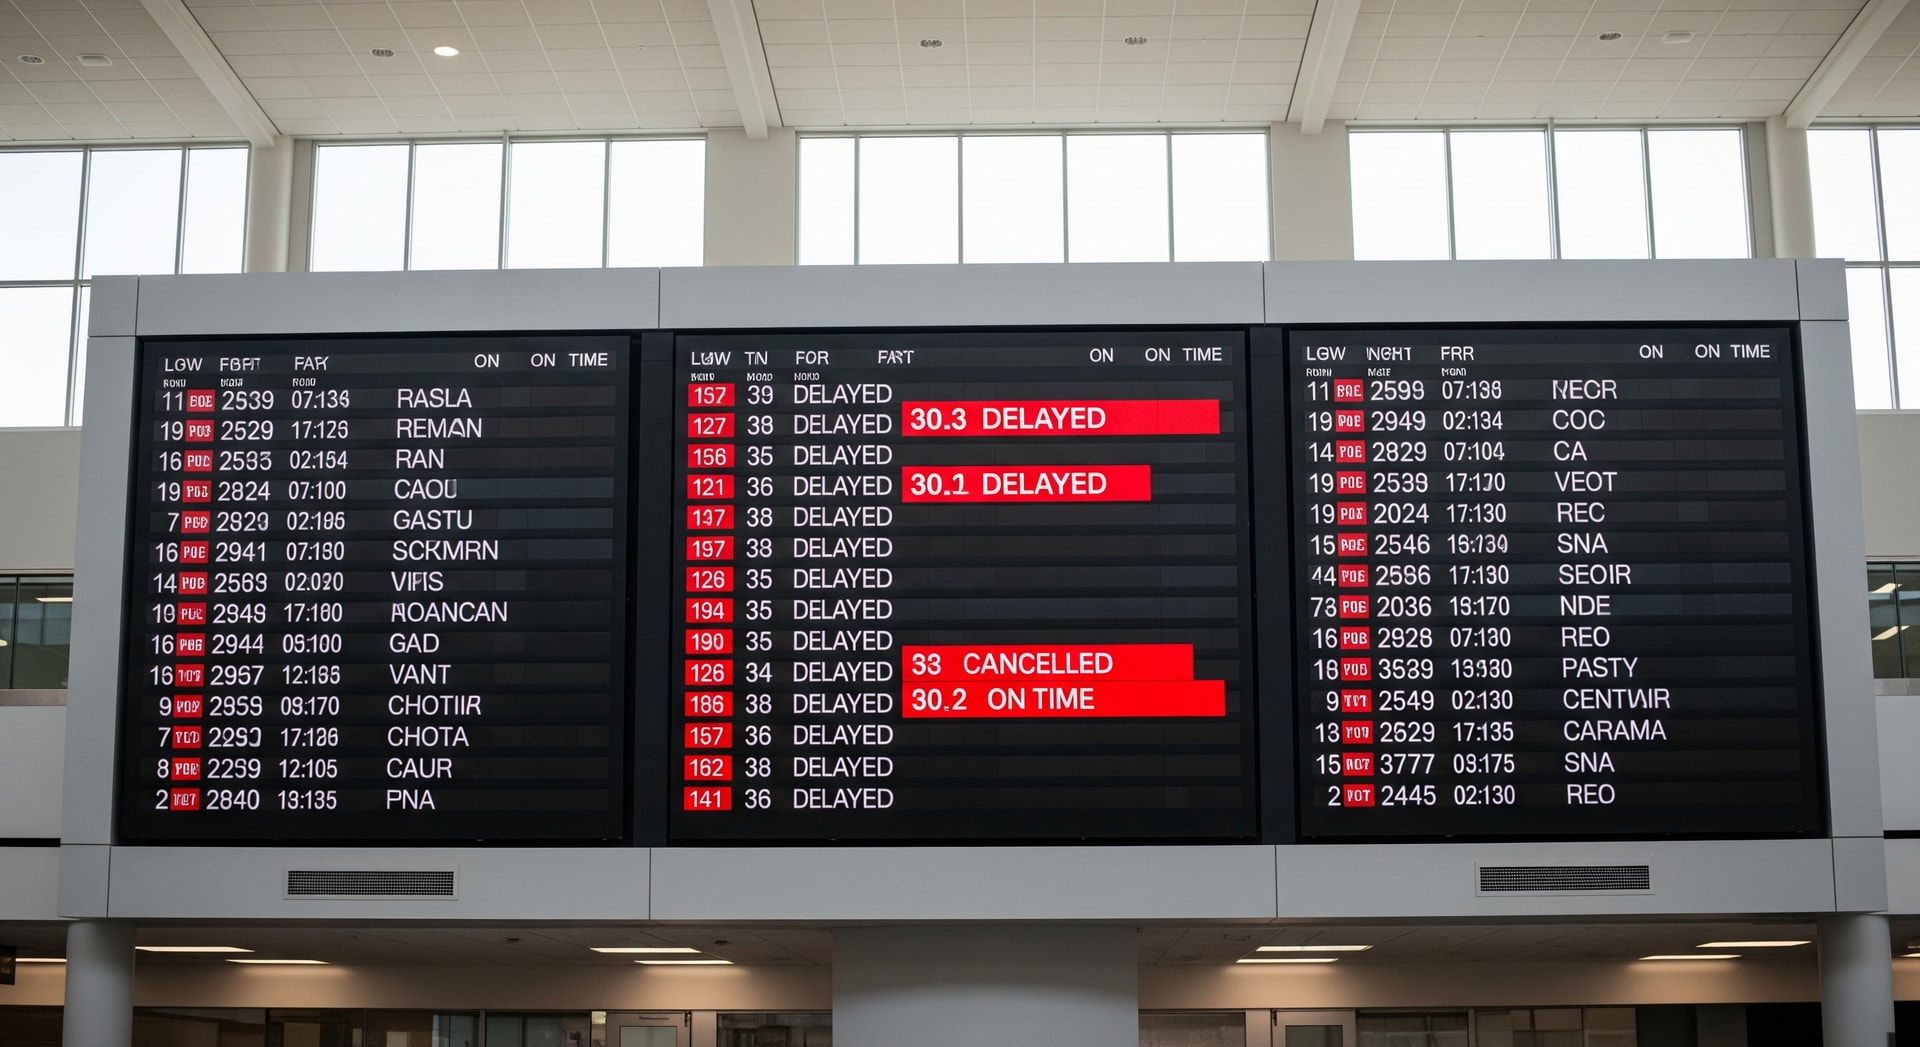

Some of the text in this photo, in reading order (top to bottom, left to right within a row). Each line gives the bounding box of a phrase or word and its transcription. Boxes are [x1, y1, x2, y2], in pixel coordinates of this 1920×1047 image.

[473, 353, 500, 369] ON
[530, 352, 556, 368] ON
[568, 352, 609, 367] TIME
[795, 346, 1223, 365] FOR ON ON TIME
[1440, 345, 1475, 362] FRR
[1639, 344, 1664, 359] ON
[1694, 343, 1721, 359] ON
[1729, 343, 1771, 359] TIME
[162, 391, 184, 411] 11
[397, 387, 473, 409] RASLA
[747, 384, 774, 405] 39
[793, 383, 893, 404] DELAYED
[1307, 380, 1329, 401] 11
[160, 420, 184, 441] 19
[220, 419, 274, 441] 2529
[396, 417, 483, 439] REMAN
[693, 413, 893, 436] 127 38 DELAYED
[910, 407, 1106, 430] 30.3 DELAYED
[1308, 411, 1333, 432] 19
[1371, 410, 1426, 432] 2949
[1442, 410, 1504, 431] 02:134
[1552, 409, 1606, 431] COC
[159, 451, 182, 472] 16
[395, 448, 445, 470] RAN
[747, 445, 774, 467] 35
[793, 444, 893, 466] DELAYED
[1308, 441, 1335, 463] 14
[1372, 441, 1427, 462] 2829
[1553, 440, 1588, 462] CA
[157, 481, 181, 502] 19
[217, 480, 271, 502] 2824
[288, 480, 347, 500] 07:100
[693, 475, 893, 497] 121 36 DELAYED
[910, 472, 1107, 496] 30.1 DELAYED
[1309, 472, 1334, 494] 19
[1554, 470, 1618, 492] VEOT
[167, 512, 180, 533] 7
[393, 509, 473, 531] GASTU
[746, 506, 893, 528] 38 DELAYED
[1310, 503, 1335, 525] 19
[1373, 502, 1430, 524] 2024
[1446, 502, 1507, 524] 17:130
[1557, 501, 1606, 523] REC
[155, 542, 179, 563] 16
[215, 541, 266, 563] 2941
[692, 537, 893, 559] 197 38 DELAYED
[1310, 534, 1336, 556] 15
[1374, 533, 1431, 555] 2546
[1557, 532, 1609, 554] SNA
[153, 572, 178, 594] 14
[692, 567, 893, 590] 126 35 DELAYED
[1558, 563, 1632, 585] SEOIR
[691, 598, 893, 621] 194 35 DELAYED
[1376, 595, 1432, 618] 2036
[1560, 594, 1611, 616] NDE
[151, 634, 174, 655] 16
[211, 633, 264, 655] 2944
[389, 632, 440, 654] GAD
[691, 630, 893, 652] 190 35 DELAYED
[1312, 627, 1338, 649] 16
[1561, 625, 1610, 648] REO
[389, 663, 452, 685] VANT
[691, 661, 893, 683] 126 34 DELAYED
[912, 652, 1113, 675] 33 CANCELLED
[1562, 656, 1638, 679] PASTY
[159, 696, 172, 717] 9
[745, 693, 772, 714] 38
[793, 692, 894, 714] DELAYED
[912, 687, 1095, 711] 30.2 ON TIME
[1326, 690, 1339, 712] 9
[1378, 689, 1435, 711] 2549
[1451, 689, 1514, 710] 02:130
[158, 726, 172, 748] 7
[387, 726, 470, 747] CHOTA
[690, 724, 894, 746] 157 36 DELAYED
[1315, 722, 1340, 743] 13
[1453, 721, 1514, 742] 17:135
[1563, 718, 1667, 742] CARAMA
[156, 758, 169, 779] 8
[279, 758, 338, 779] 12:105
[386, 757, 453, 779] CAUR
[689, 756, 894, 778] 162 38 DELAYED
[1316, 753, 1341, 775] 15
[1380, 753, 1435, 775] 3777
[1564, 751, 1615, 773] SNA
[155, 789, 169, 810] 2
[206, 788, 260, 810] 2840
[386, 789, 436, 810] PNA
[690, 787, 894, 809] 141 36 DELAYED
[1327, 785, 1342, 807] 2
[1381, 784, 1437, 806] 2445
[1453, 784, 1516, 806] 02:130
[1566, 783, 1616, 805] REO
